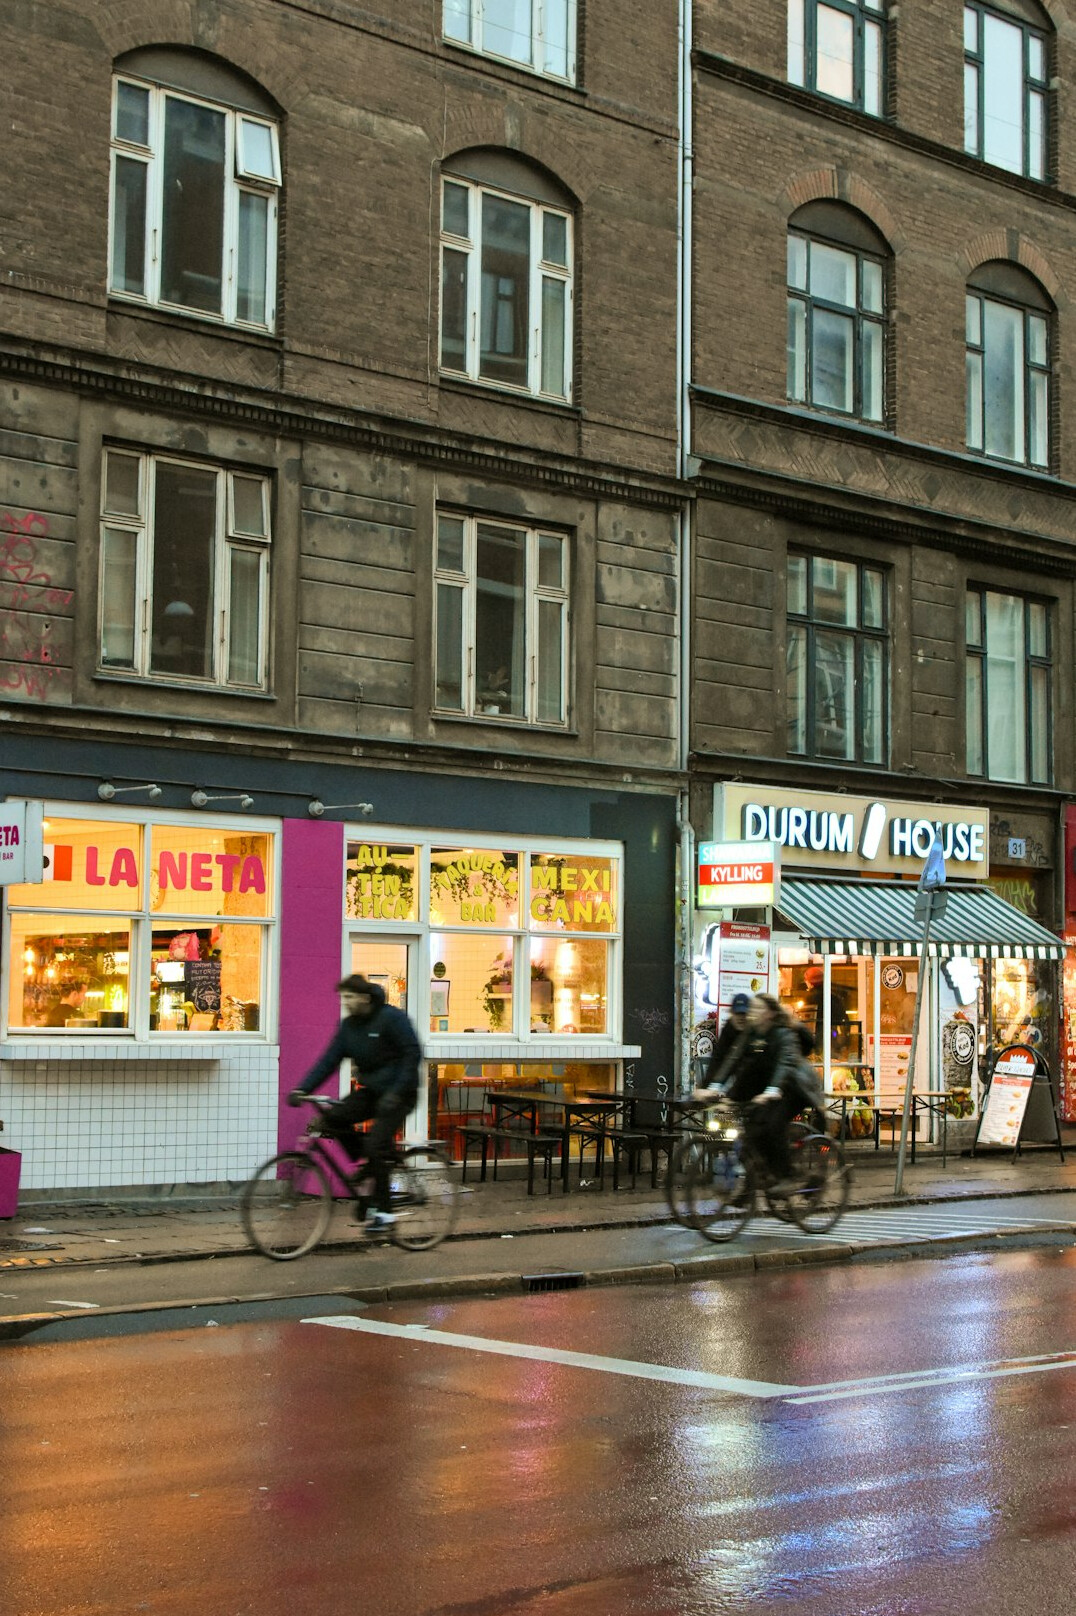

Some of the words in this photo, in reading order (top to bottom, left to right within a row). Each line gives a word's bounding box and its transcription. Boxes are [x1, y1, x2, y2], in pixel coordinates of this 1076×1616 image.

[889, 818, 984, 862] HOUSE
[1012, 842, 1022, 855] 31
[2, 852, 14, 860] BAR
[86, 846, 138, 888] LA
[159, 851, 266, 895] NETA
[531, 865, 611, 892] MEXI
[711, 865, 763, 882] KYLLING
[359, 896, 408, 919] TICA
[461, 902, 496, 922] BAR
[530, 897, 614, 924] CANA
